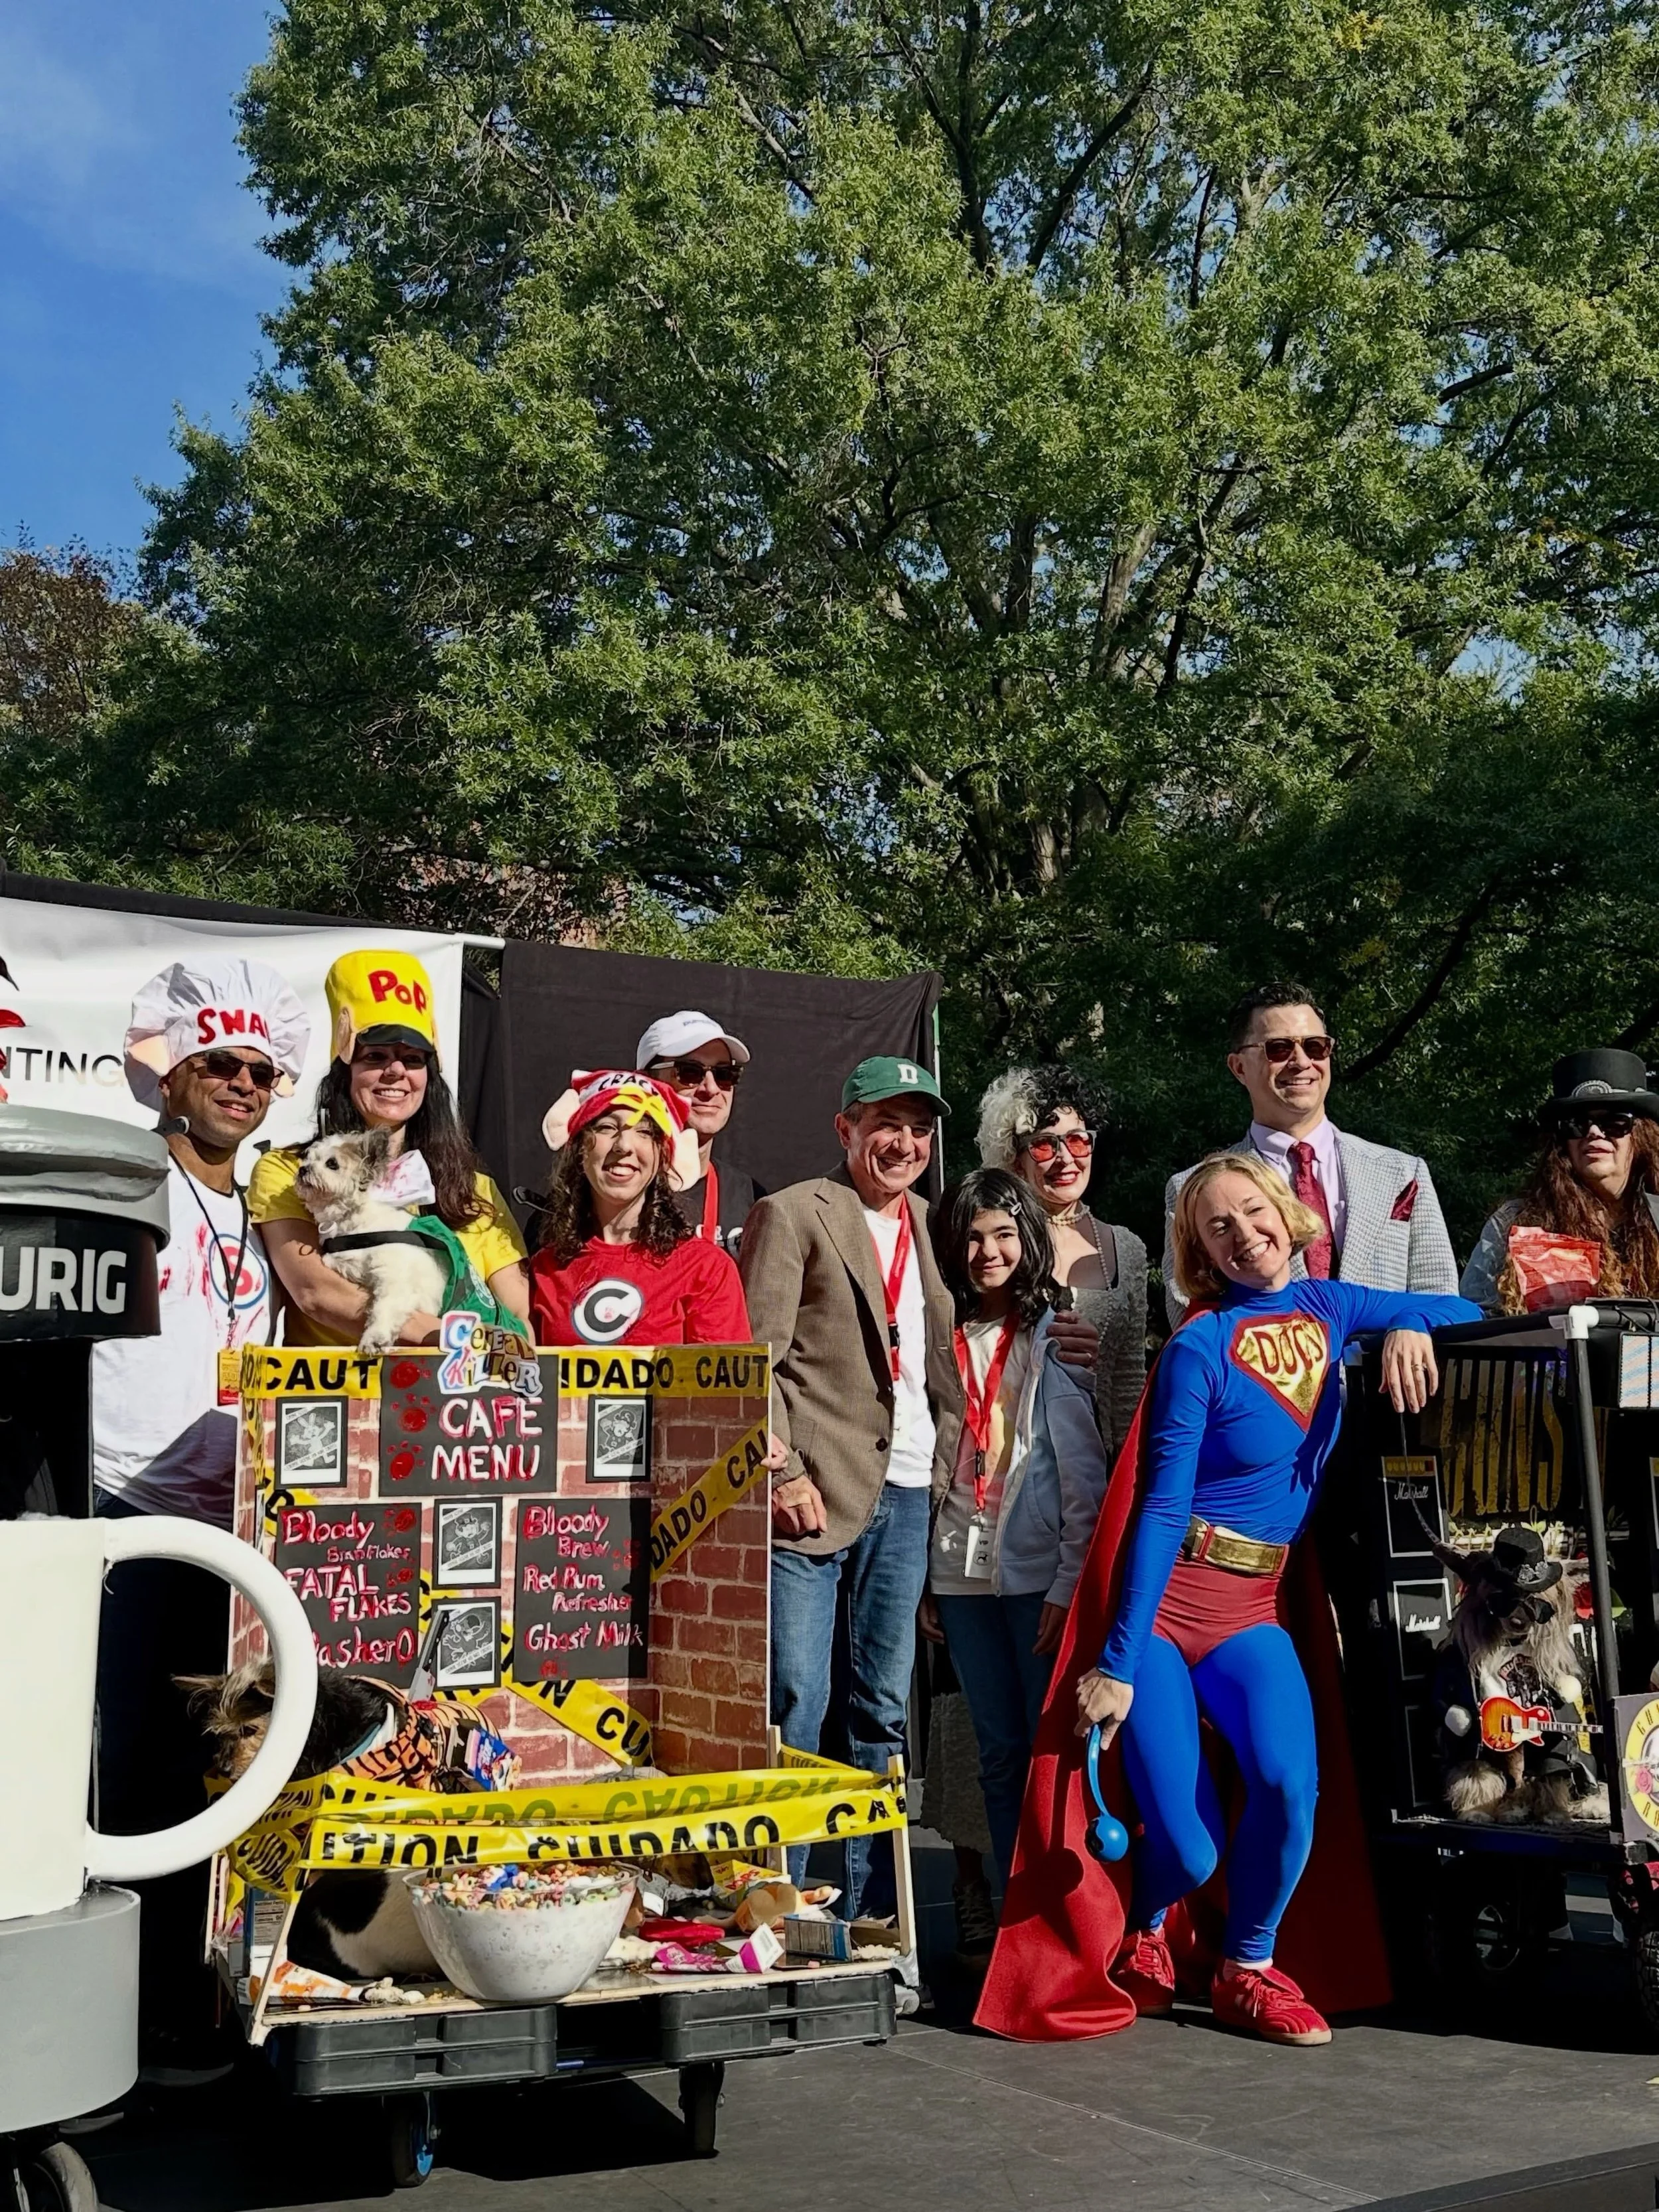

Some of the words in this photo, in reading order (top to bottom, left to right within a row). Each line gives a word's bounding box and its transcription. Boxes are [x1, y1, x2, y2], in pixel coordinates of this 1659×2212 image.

[197, 1007, 271, 1045] SNA
[897, 1064, 918, 1084] D
[0, 1246, 127, 1314] URIG
[584, 1288, 629, 1333] C
[439, 1396, 543, 1441] CAFE
[432, 1443, 540, 1481] MENU
[281, 1509, 375, 1549] Bloody
[524, 1504, 609, 1542] Bloody
[558, 1536, 610, 1558] Brew
[285, 1563, 382, 1601] FATAL
[523, 1564, 557, 1593] Red
[563, 1563, 605, 1591] Rum
[526, 1622, 591, 1652] Ghost
[596, 1620, 644, 1651] Milk
